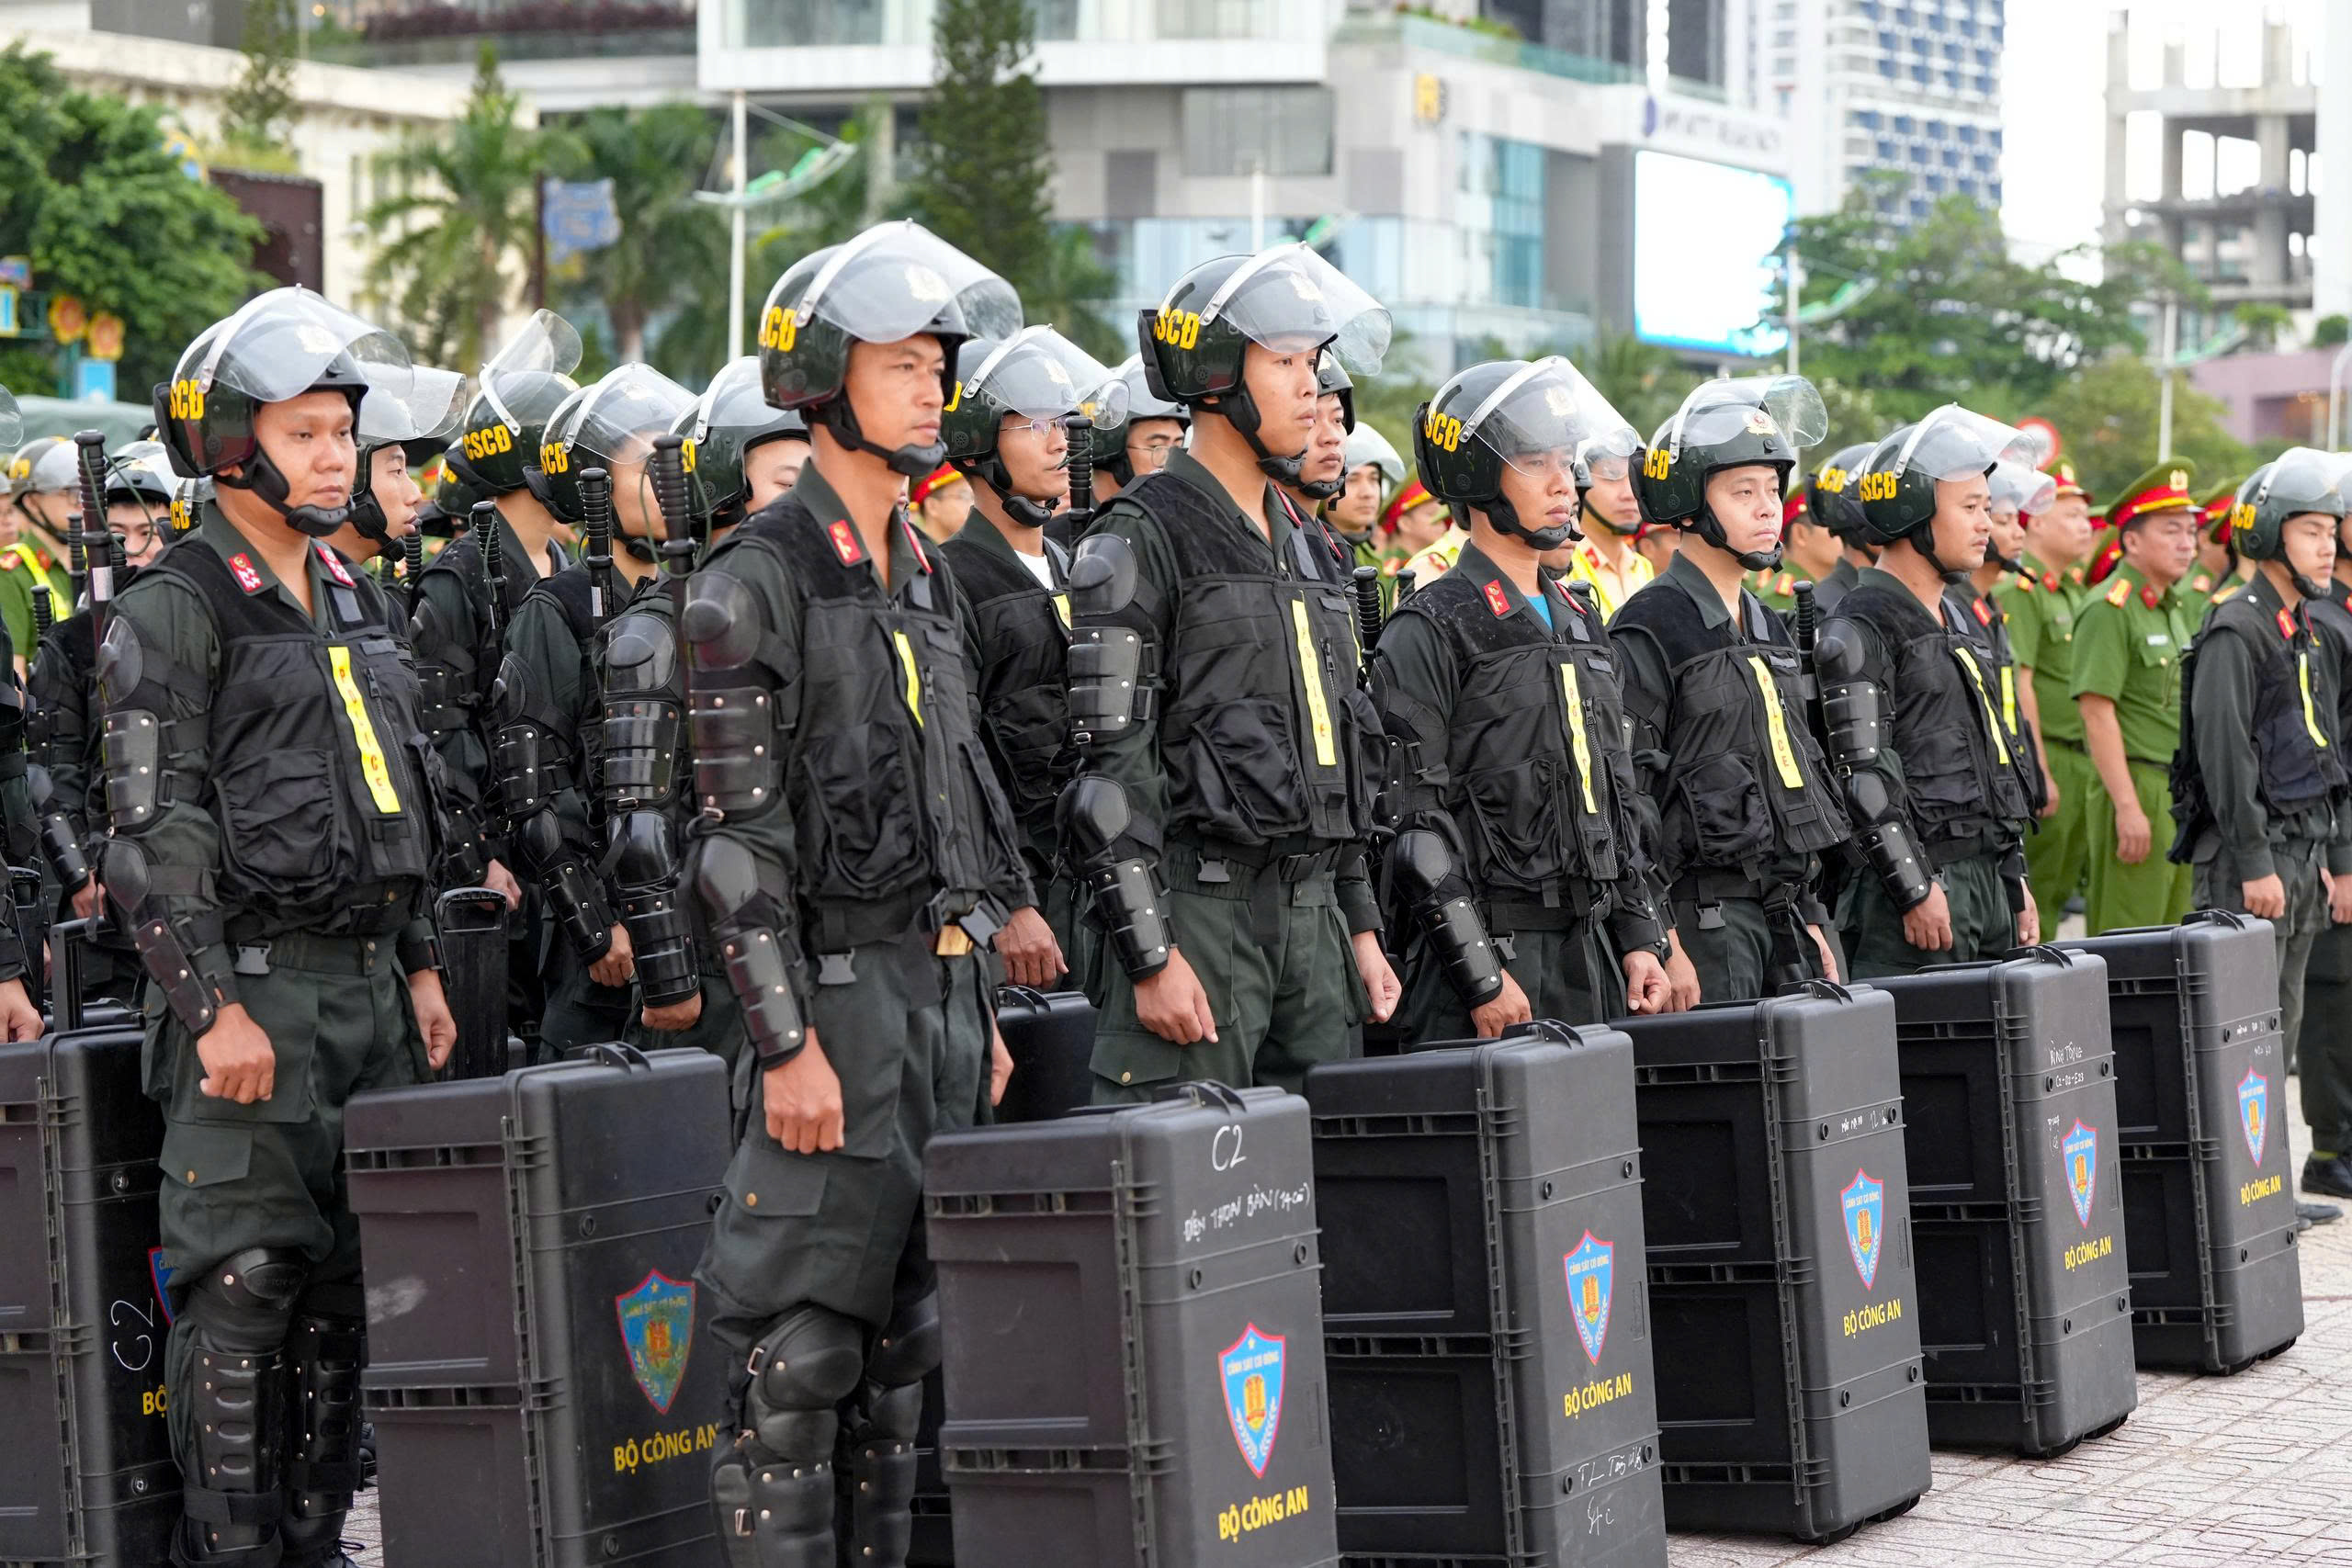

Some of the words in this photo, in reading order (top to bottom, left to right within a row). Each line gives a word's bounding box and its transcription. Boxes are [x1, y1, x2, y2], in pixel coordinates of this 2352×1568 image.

[1763, 675, 1791, 768] POLICE
[1212, 1123, 1248, 1172] C2
[2240, 1182, 2251, 1208] BỘ
[2251, 1179, 2270, 1201] CÔNG
[2270, 1175, 2281, 1194] AN
[2064, 1246, 2076, 1272] BỘ
[2076, 1240, 2098, 1265] CÔNG
[2099, 1235, 2111, 1258] AN
[110, 1297, 154, 1371] C2
[1843, 1309, 1858, 1339] BỘ
[1858, 1303, 1886, 1331] CÔNG
[1887, 1298, 1902, 1322] AN
[142, 1384, 169, 1419] BỘ
[1564, 1386, 1581, 1420] BỘ
[1581, 1379, 1614, 1410] CÔNG
[1615, 1372, 1633, 1399] AN
[613, 1438, 639, 1475] BỘ
[641, 1430, 692, 1464] CÔNG
[1218, 1503, 1241, 1544] BỘ
[1241, 1495, 1284, 1532] CÔNG
[1286, 1484, 1309, 1517] AN
